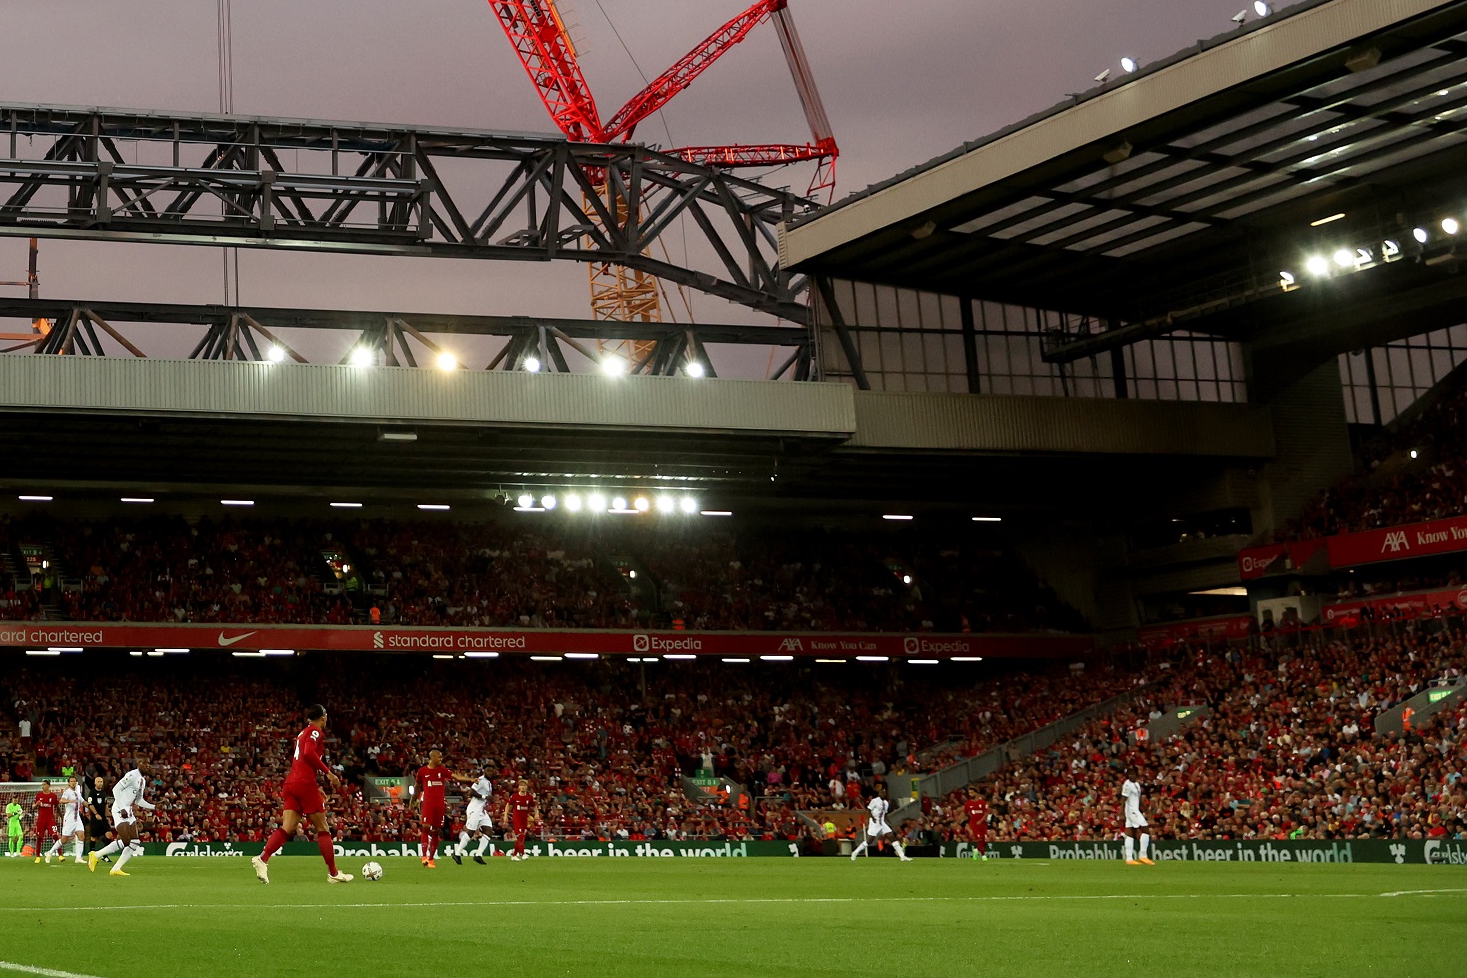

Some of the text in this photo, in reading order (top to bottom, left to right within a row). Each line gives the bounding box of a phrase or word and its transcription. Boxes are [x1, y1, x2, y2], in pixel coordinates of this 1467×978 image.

[1381, 526, 1467, 553] AXA Know Yo
[30, 629, 103, 643] chartered
[388, 634, 526, 648] standard chartered
[651, 637, 702, 652] Expedia
[778, 637, 877, 651] AXA Know You Can
[921, 640, 970, 653] Expedia
